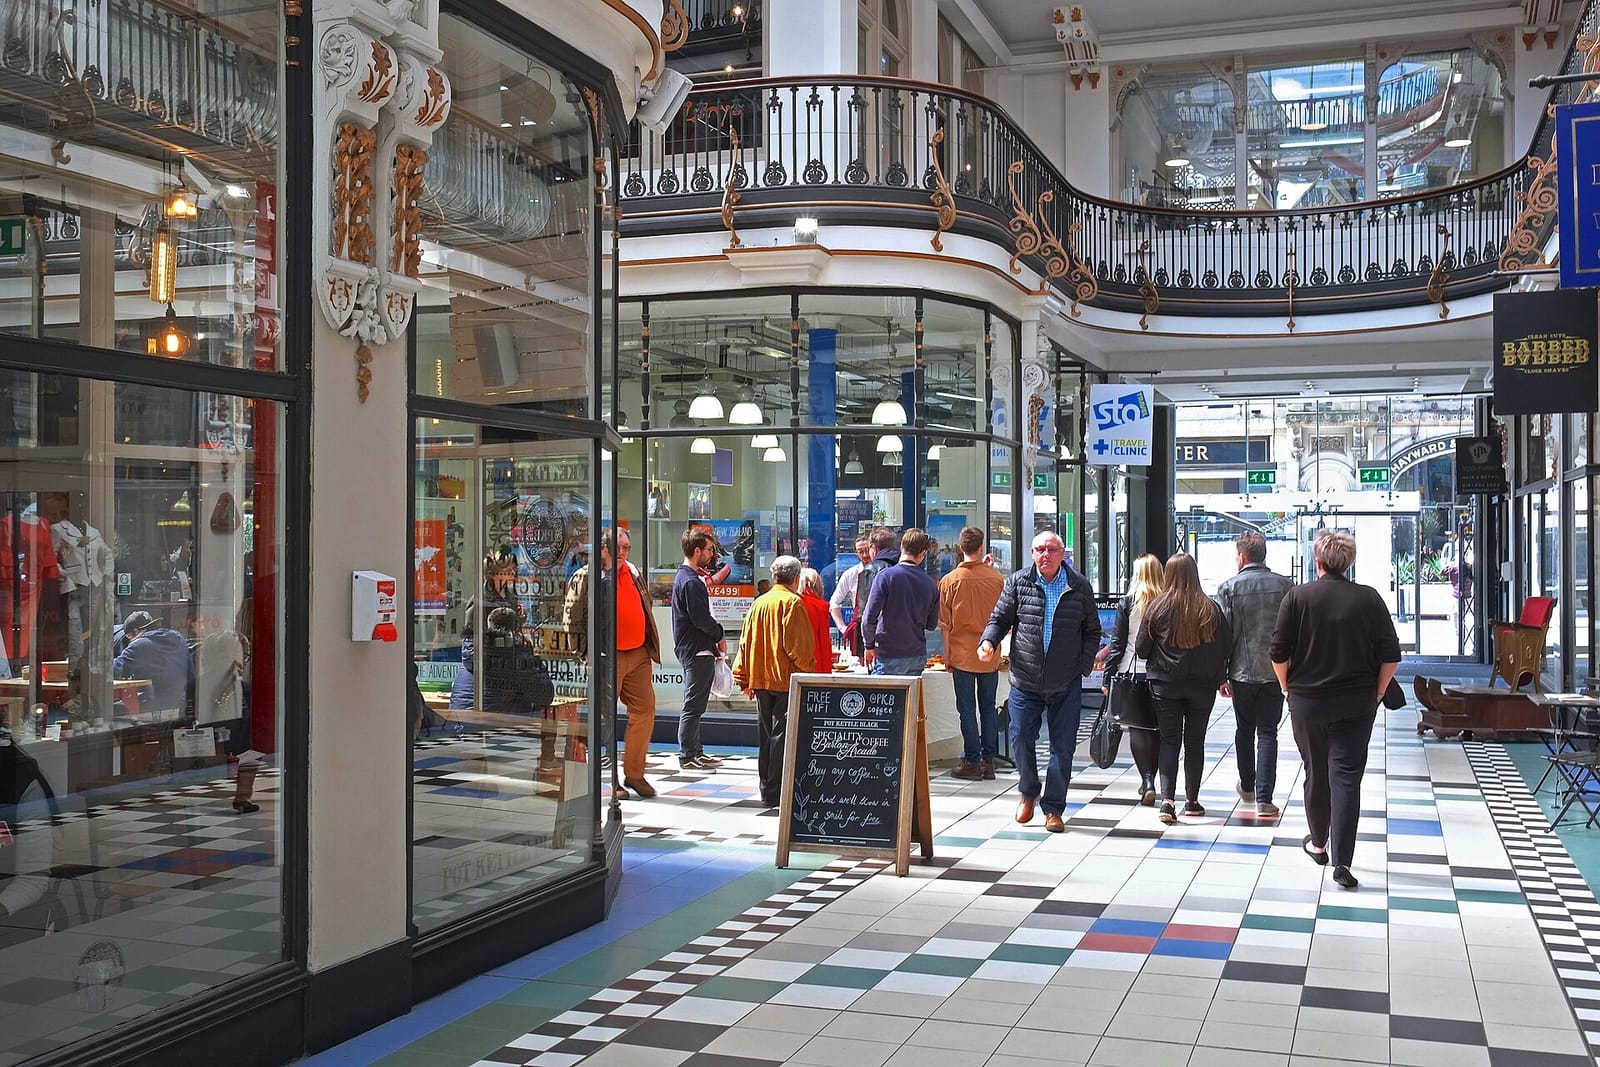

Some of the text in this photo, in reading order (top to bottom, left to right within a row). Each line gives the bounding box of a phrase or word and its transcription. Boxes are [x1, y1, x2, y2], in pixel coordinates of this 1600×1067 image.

[1503, 339, 1590, 355] BARBER
[1113, 446, 1148, 456] CLINIC
[1391, 441, 1446, 474] HAYWARD
[728, 526, 753, 537] ZEALAND
[714, 587, 738, 596] £499
[652, 674, 683, 684] INSTO
[807, 691, 831, 704] FREE
[869, 693, 895, 706] @PKB
[806, 703, 828, 713] WIFI
[867, 706, 893, 716] coffee
[813, 730, 863, 741] SPECIALITY
[837, 740, 877, 760] Arcade
[808, 758, 827, 787] Buy
[881, 798, 890, 807] in
[812, 811, 819, 819] a
[839, 810, 860, 829] for
